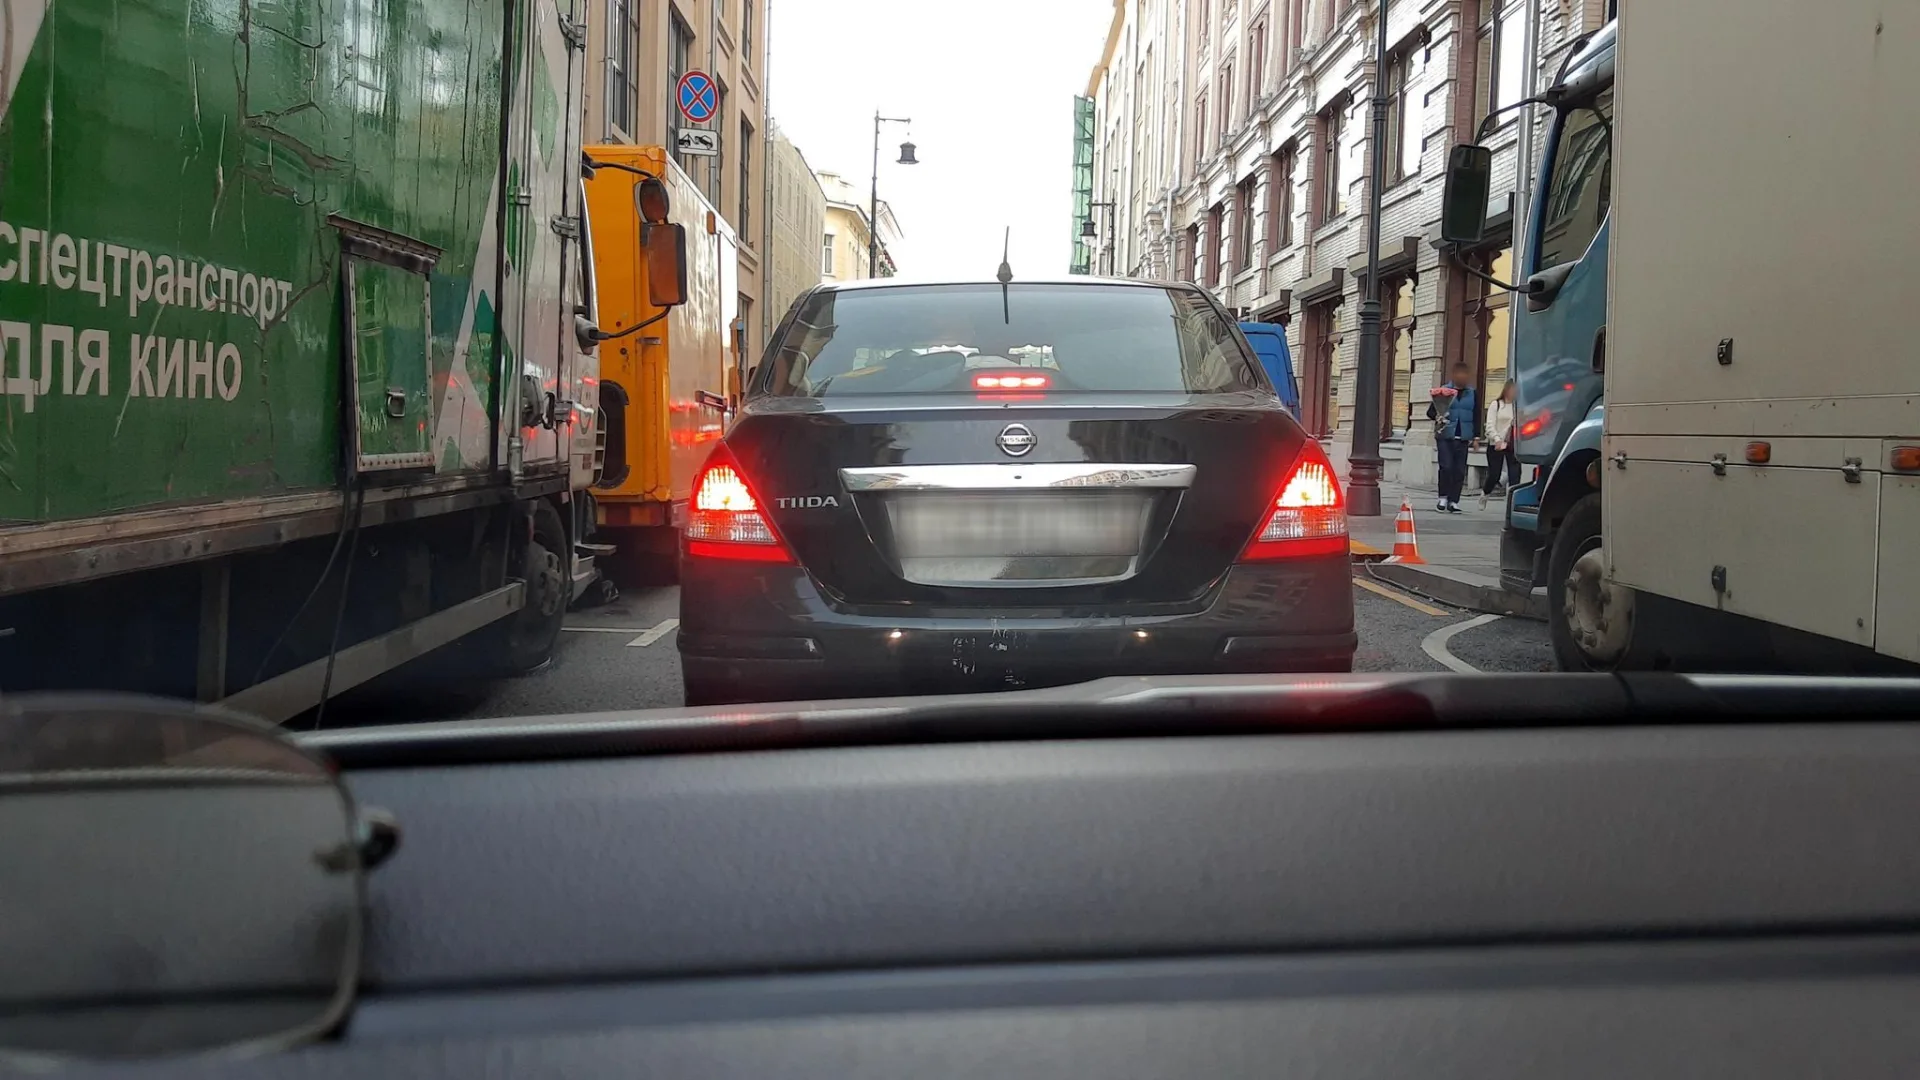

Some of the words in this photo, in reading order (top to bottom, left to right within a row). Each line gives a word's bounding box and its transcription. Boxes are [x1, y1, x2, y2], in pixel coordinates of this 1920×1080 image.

[0, 221, 293, 330] спецтранспорт
[130, 333, 243, 401] КИНО
[775, 495, 839, 509] TIIDA
